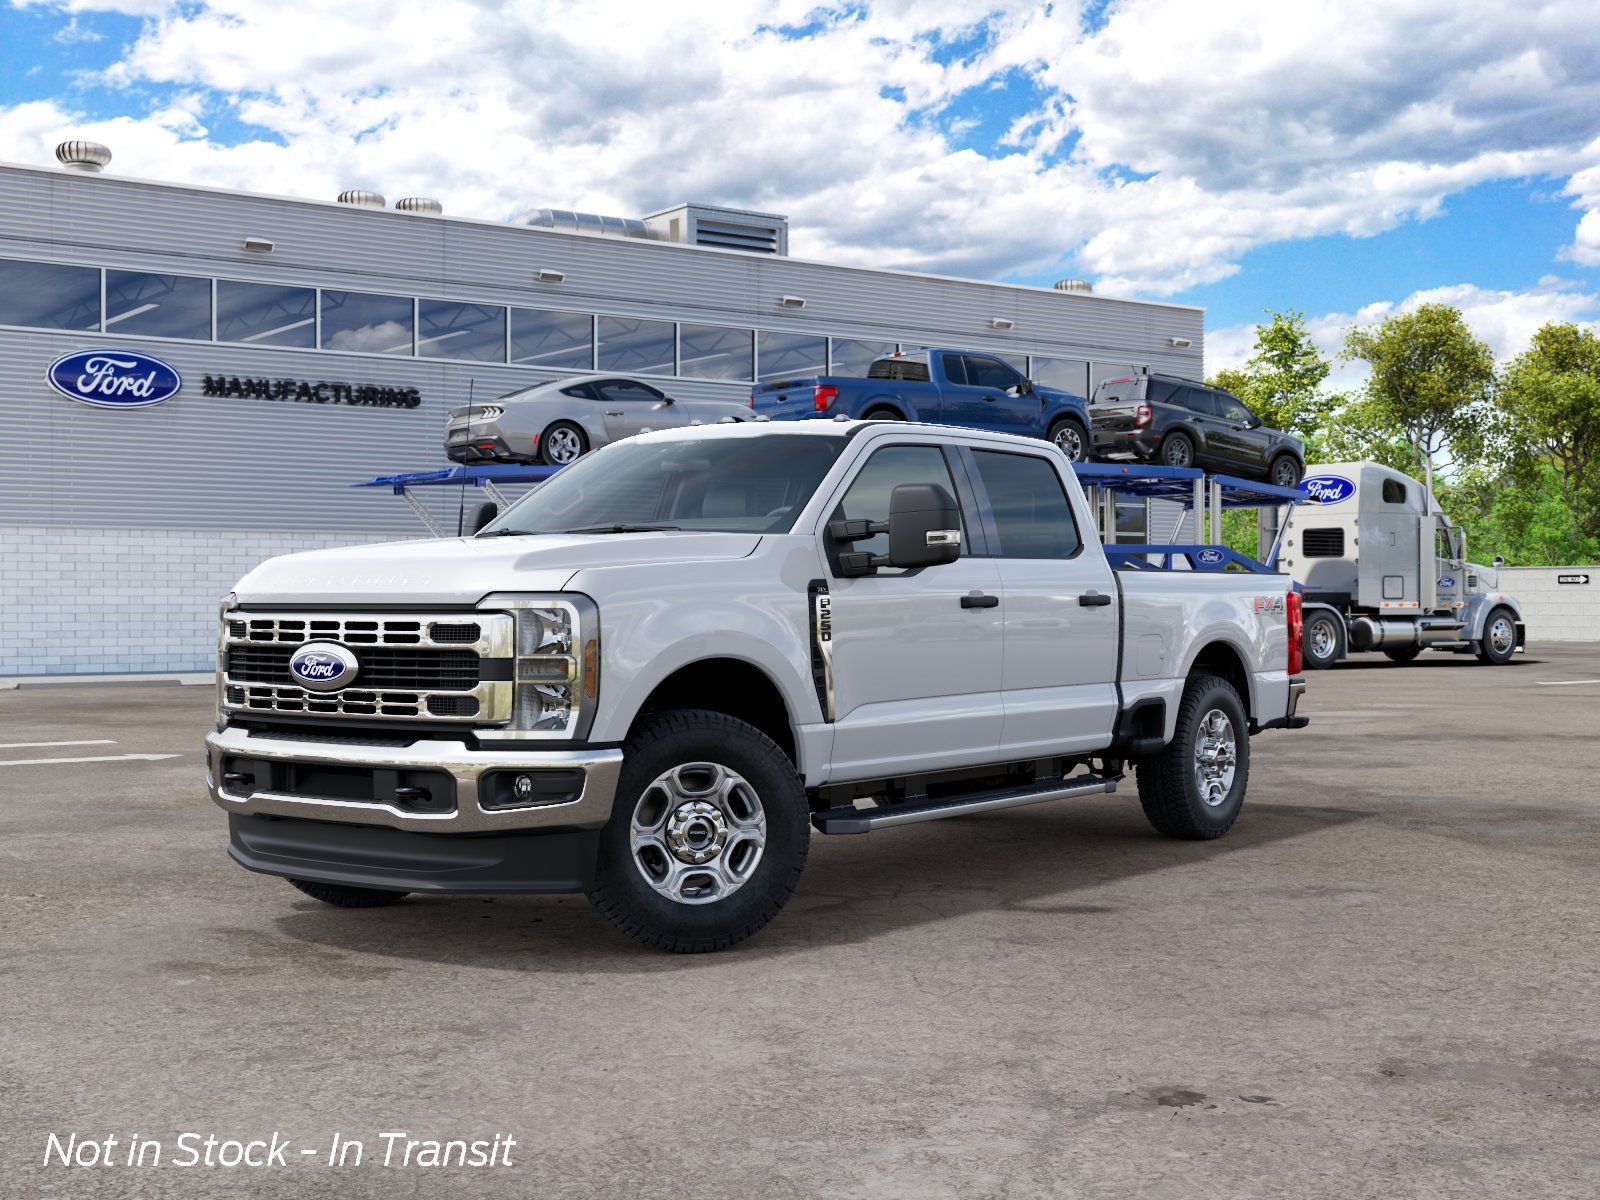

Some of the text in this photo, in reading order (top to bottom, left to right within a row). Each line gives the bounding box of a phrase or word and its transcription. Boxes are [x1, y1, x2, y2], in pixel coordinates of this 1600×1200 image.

[77, 357, 156, 397] Ford
[204, 374, 421, 409] MANUFACTURING
[1305, 480, 1343, 499] Ford
[1254, 597, 1283, 614] FX4
[301, 655, 335, 677] Ford
